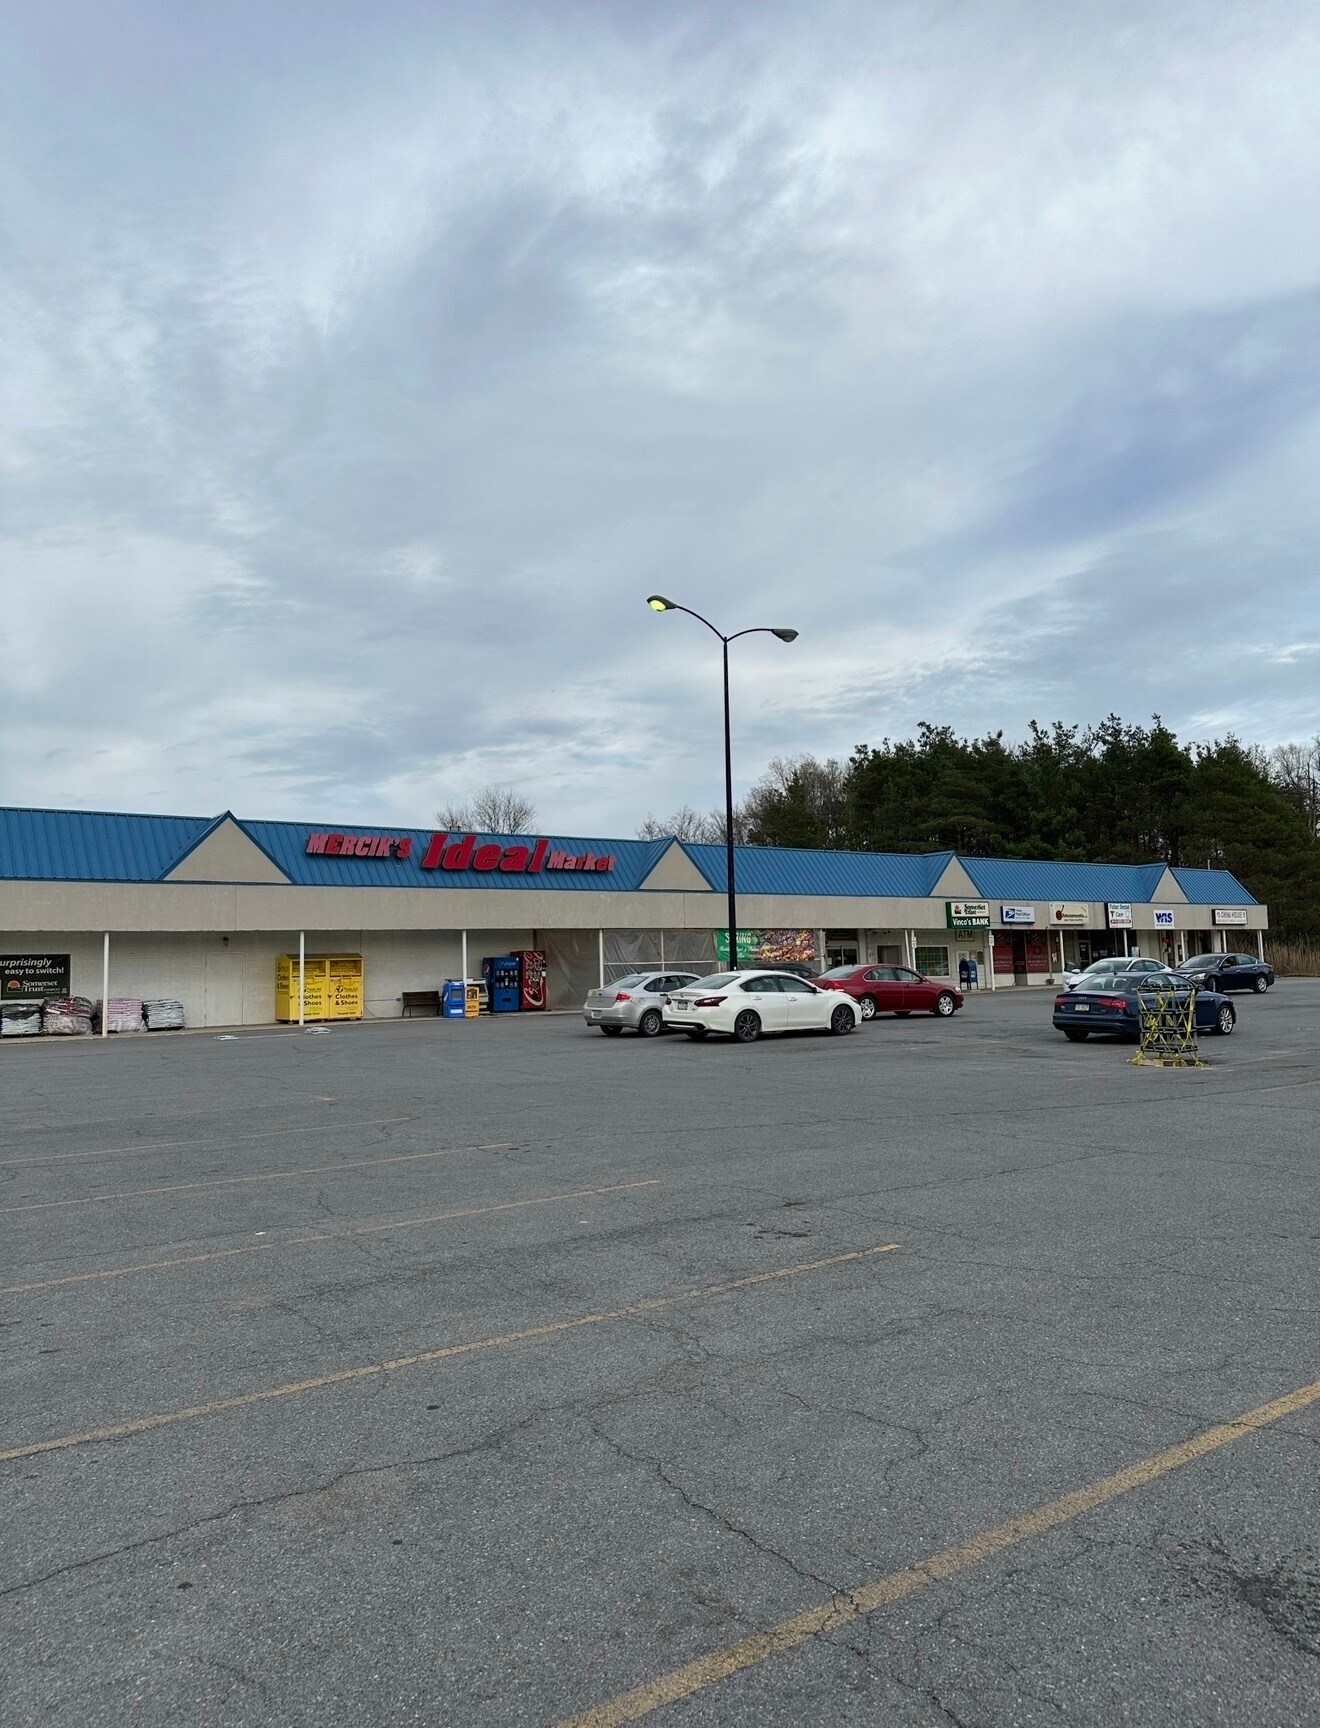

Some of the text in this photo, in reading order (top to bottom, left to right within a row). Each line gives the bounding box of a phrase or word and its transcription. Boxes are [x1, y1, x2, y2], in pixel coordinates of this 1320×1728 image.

[306, 832, 616, 872] MERCIK'S Ideal Market
[972, 918, 990, 926] BANK
[725, 932, 752, 944] SRING
[958, 930, 973, 938] ATM
[0, 957, 52, 968] urprisingly
[4, 968, 25, 976] easy
[35, 966, 65, 975] switch!
[22, 979, 58, 987] Somerset
